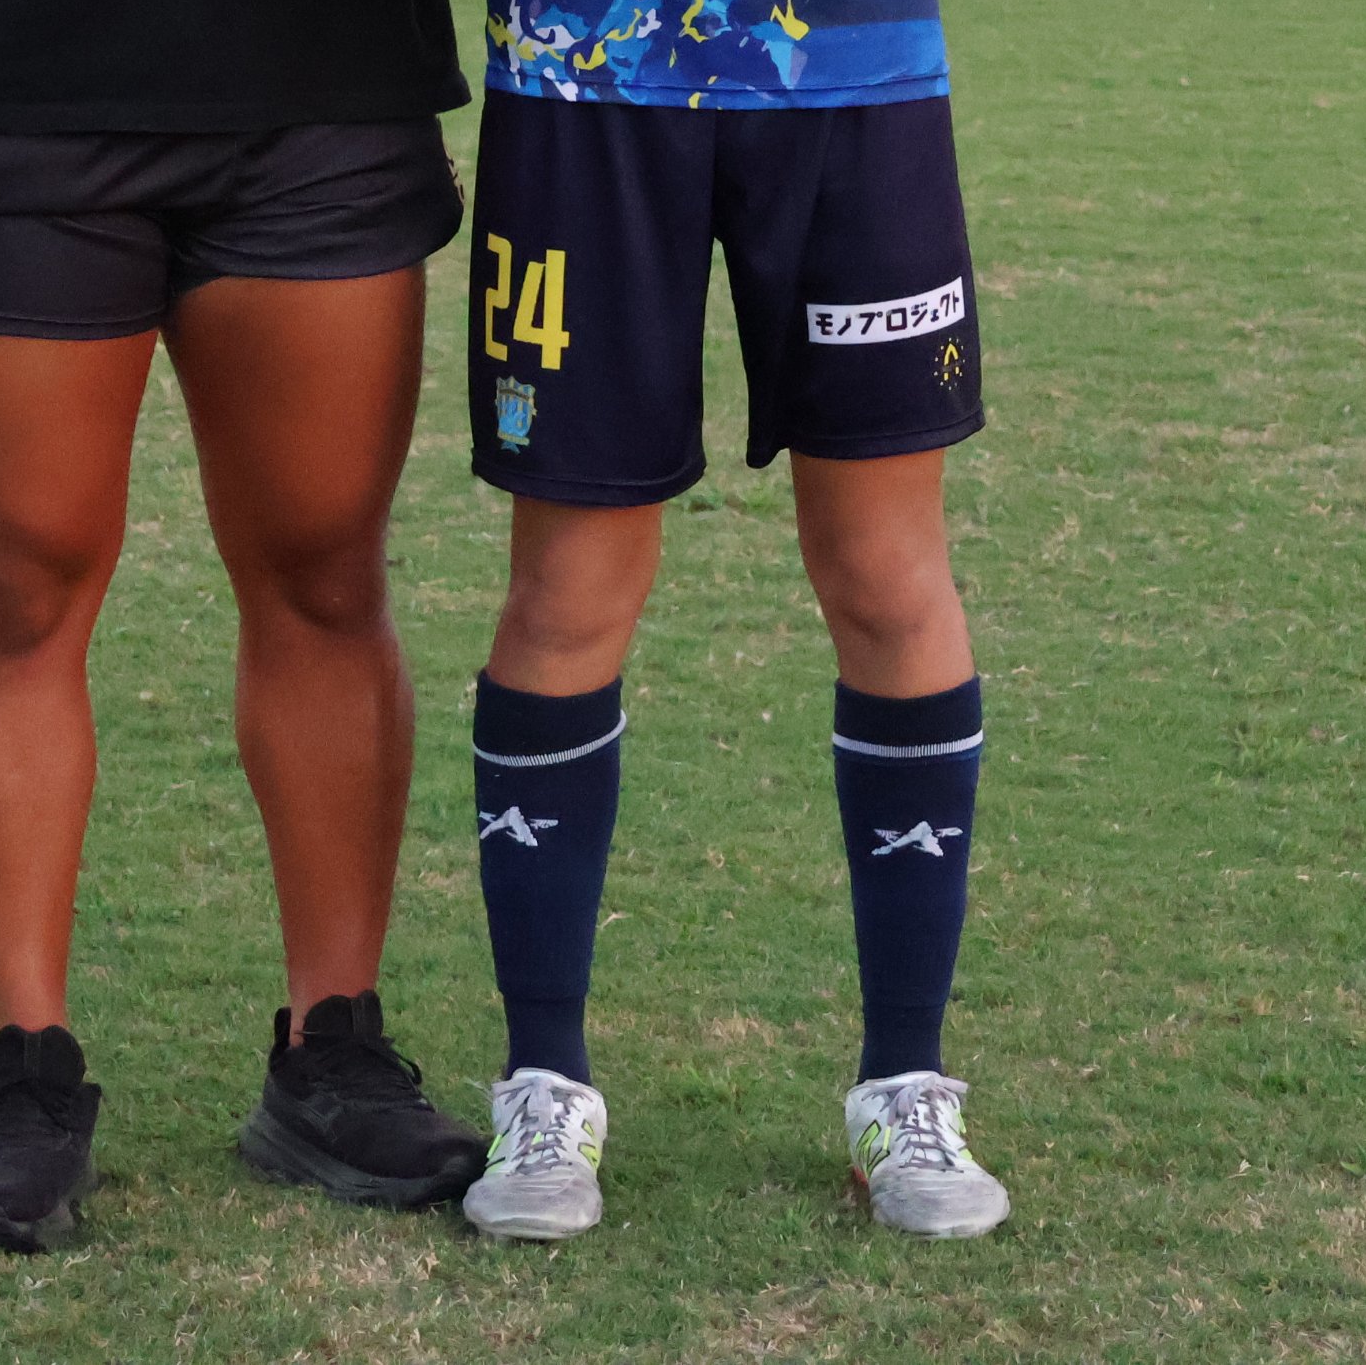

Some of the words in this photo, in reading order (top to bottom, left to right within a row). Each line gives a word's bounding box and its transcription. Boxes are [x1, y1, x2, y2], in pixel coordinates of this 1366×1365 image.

[485, 232, 570, 370] 24
[815, 290, 960, 336] モノプロジェクト
